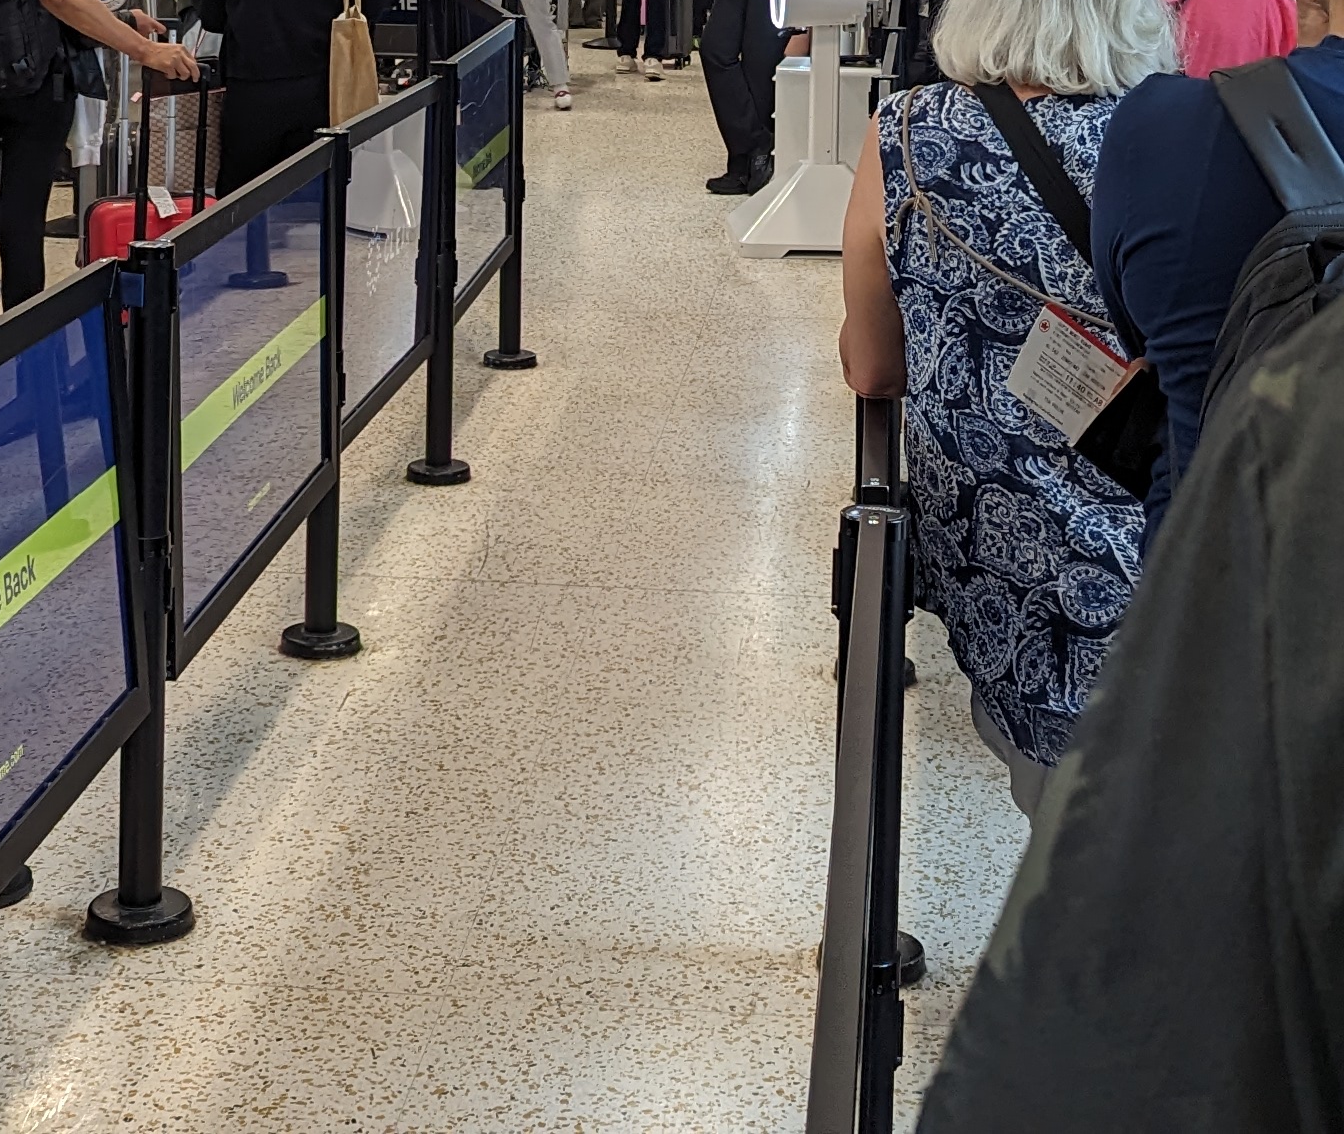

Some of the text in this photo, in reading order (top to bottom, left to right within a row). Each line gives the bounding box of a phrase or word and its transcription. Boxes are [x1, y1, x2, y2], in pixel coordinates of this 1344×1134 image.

[233, 345, 281, 410] Welcome Back
[3, 554, 36, 606] Back
